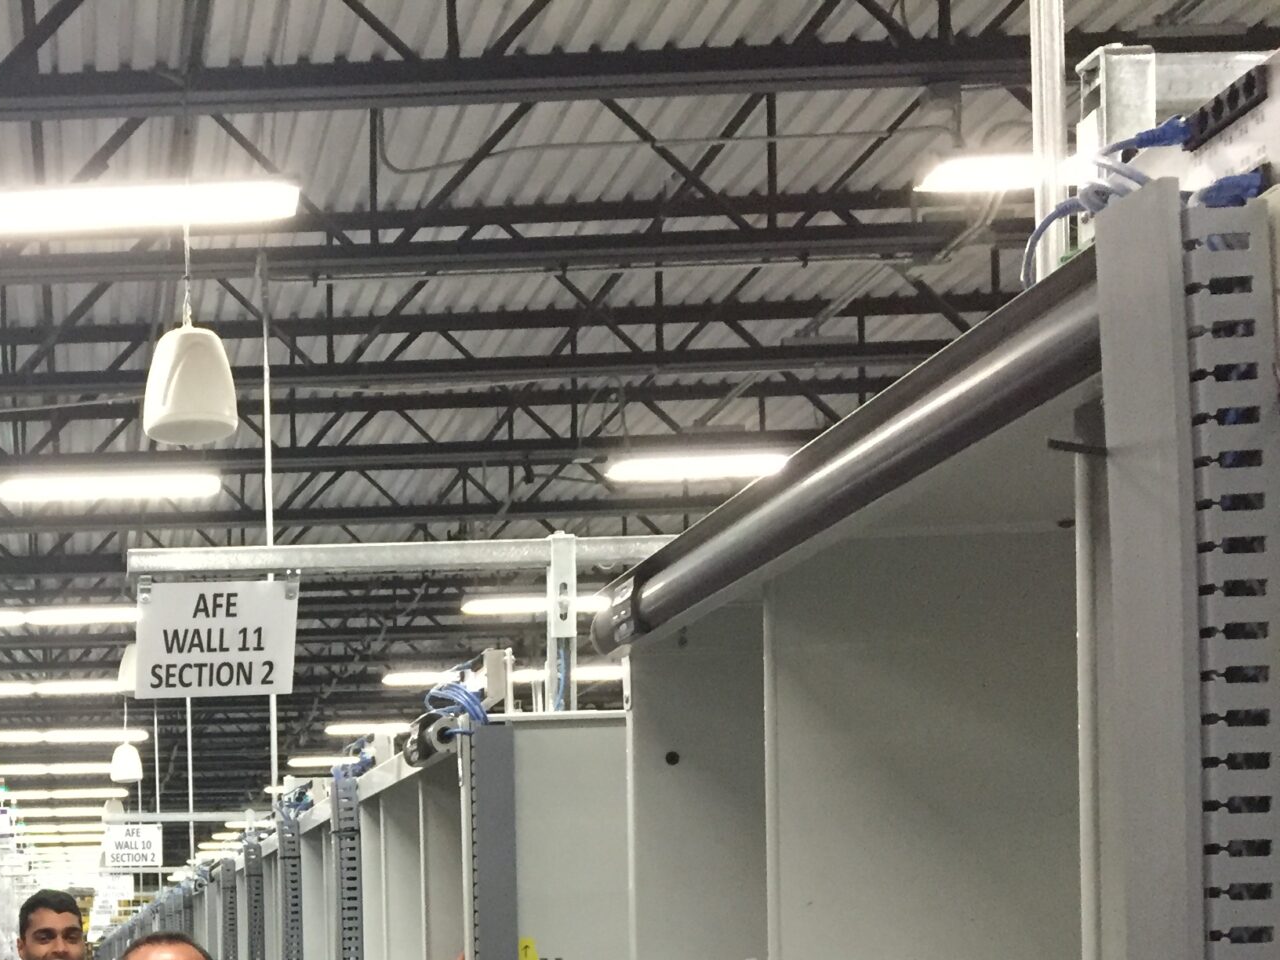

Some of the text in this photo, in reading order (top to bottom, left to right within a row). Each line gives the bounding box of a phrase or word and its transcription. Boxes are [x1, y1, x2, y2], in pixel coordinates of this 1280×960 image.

[192, 592, 238, 618] AFE
[163, 626, 265, 654] WALL 11
[150, 660, 274, 689] SECTION 2
[125, 828, 141, 838] AFE
[114, 840, 152, 850] WALL 10
[110, 853, 156, 863] SECTION 2
